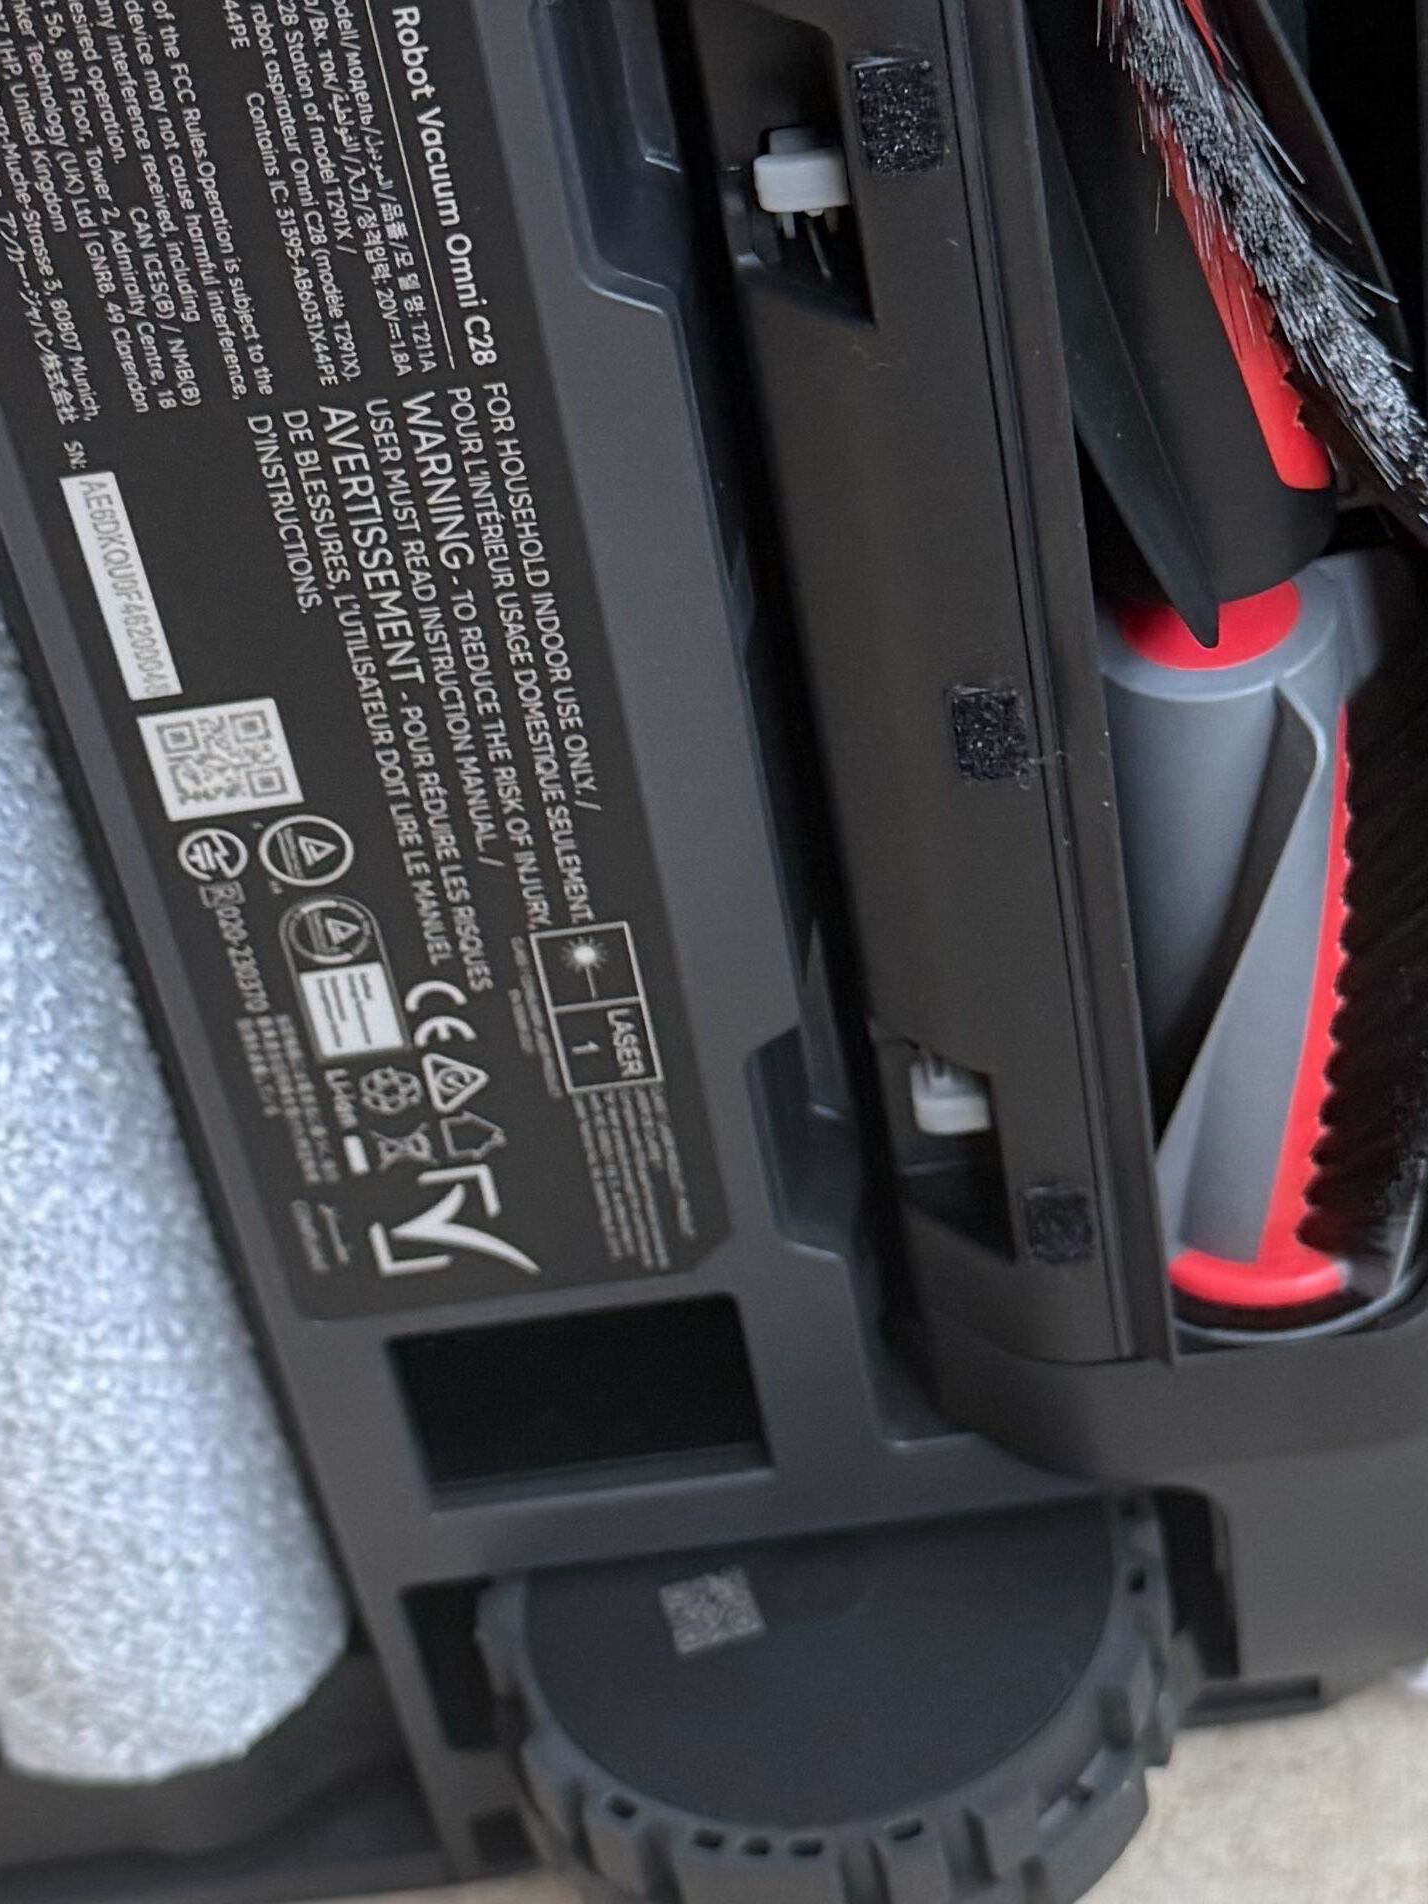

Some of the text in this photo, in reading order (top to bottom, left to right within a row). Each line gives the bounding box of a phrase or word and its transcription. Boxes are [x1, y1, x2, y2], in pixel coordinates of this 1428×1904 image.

[42, 10, 67, 45] 56,
[157, 23, 181, 59] the
[248, 1, 279, 58] robot
[24, 39, 70, 148] Technology
[52, 47, 80, 83] 8th
[168, 61, 197, 104] FCC
[283, 28, 315, 100] Station
[64, 85, 95, 143] Floor,
[84, 64, 128, 165] operation.
[262, 58, 303, 155] aspirateur
[301, 100, 326, 123] of
[53, 149, 86, 196] (UK)
[83, 143, 114, 203] Tower
[288, 156, 321, 208] Omni
[307, 125, 341, 185] model
[69, 196, 99, 229] Ltd
[99, 204, 122, 226] 2,
[323, 184, 355, 241] T291X
[390, 4, 498, 367] Robot Vacuum Omni C28
[127, 205, 157, 250] CAN
[301, 208, 329, 246] C28
[41, 277, 64, 297] 3,
[106, 227, 148, 318] Admiralty
[221, 255, 243, 275] is
[308, 246, 346, 320] (modèle
[47, 296, 83, 352] 80807
[104, 299, 127, 325] 49
[226, 275, 261, 342] subject
[109, 325, 150, 414] Clarendon
[134, 319, 166, 387] Centre,
[245, 342, 265, 364] to
[331, 318, 362, 383] T291X).
[409, 318, 438, 374] T211A
[66, 354, 102, 422] Munich,
[155, 387, 178, 410] 18
[251, 364, 274, 396] the
[480, 380, 516, 435] FOR
[363, 396, 403, 465] USER
[445, 385, 485, 456] POUR
[381, 466, 422, 534] MUST
[400, 389, 476, 571] WARNING
[245, 412, 324, 615] D'INSTRUCTIONS.
[461, 456, 516, 590] L'INTÉRIEUR
[494, 436, 551, 588] HOUSEHOLD
[399, 537, 438, 603] READ
[449, 587, 478, 622] TO
[493, 590, 535, 666] USAGE
[529, 590, 573, 684] INDOOR
[281, 407, 453, 967] DE BLESSURES, L'UTILISATEUR DOIT LIRE LE MANUEL
[316, 404, 494, 992] AVERTISSEMENT POUR RÉDUIRE LES RISQUES
[416, 604, 476, 753] INSTRUCTION
[457, 624, 502, 717] REDUCE
[511, 666, 567, 803] DOMESTIQUE
[551, 684, 585, 731] USE
[480, 716, 514, 763] THE
[491, 764, 526, 815] RISK
[503, 815, 535, 847] OF
[397, 970, 479, 1052] CE
[568, 1036, 602, 1058] 1
[604, 1004, 647, 1080] LASER
